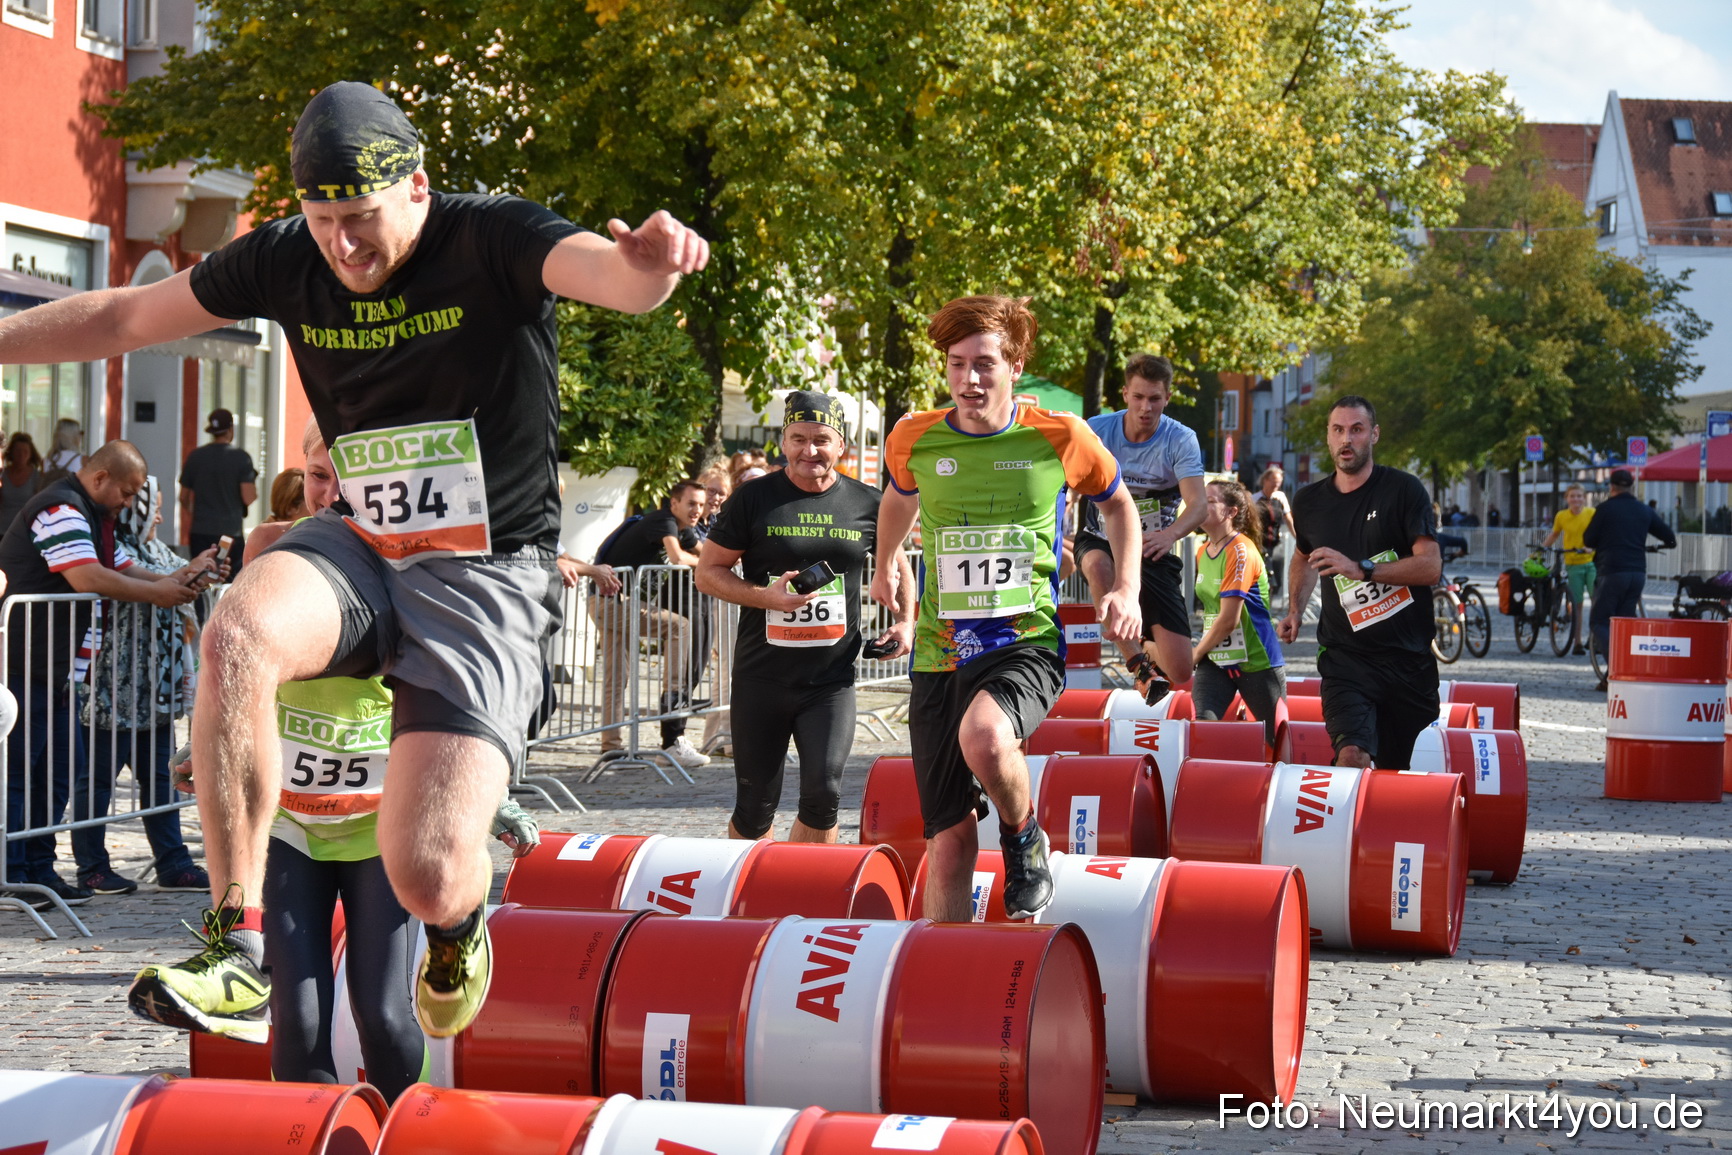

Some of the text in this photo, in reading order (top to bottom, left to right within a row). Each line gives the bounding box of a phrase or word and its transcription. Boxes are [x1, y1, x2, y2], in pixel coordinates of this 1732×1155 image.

[351, 295, 406, 323] TEAM
[301, 306, 464, 350] FORREST GUMP
[338, 427, 465, 473] BOCK
[994, 460, 1033, 470] BOCK
[363, 476, 449, 527] 534
[766, 526, 862, 541] FORREST GUMP
[797, 513, 834, 525] TEAM
[942, 529, 1027, 552] BOCK
[957, 558, 1013, 587] 113
[967, 594, 1002, 608] NILS
[1360, 594, 1401, 620] FLORIAN
[284, 710, 389, 751] BOCK
[290, 750, 370, 788] 535
[978, 886, 990, 921] energie
[677, 1039, 686, 1089] energie
